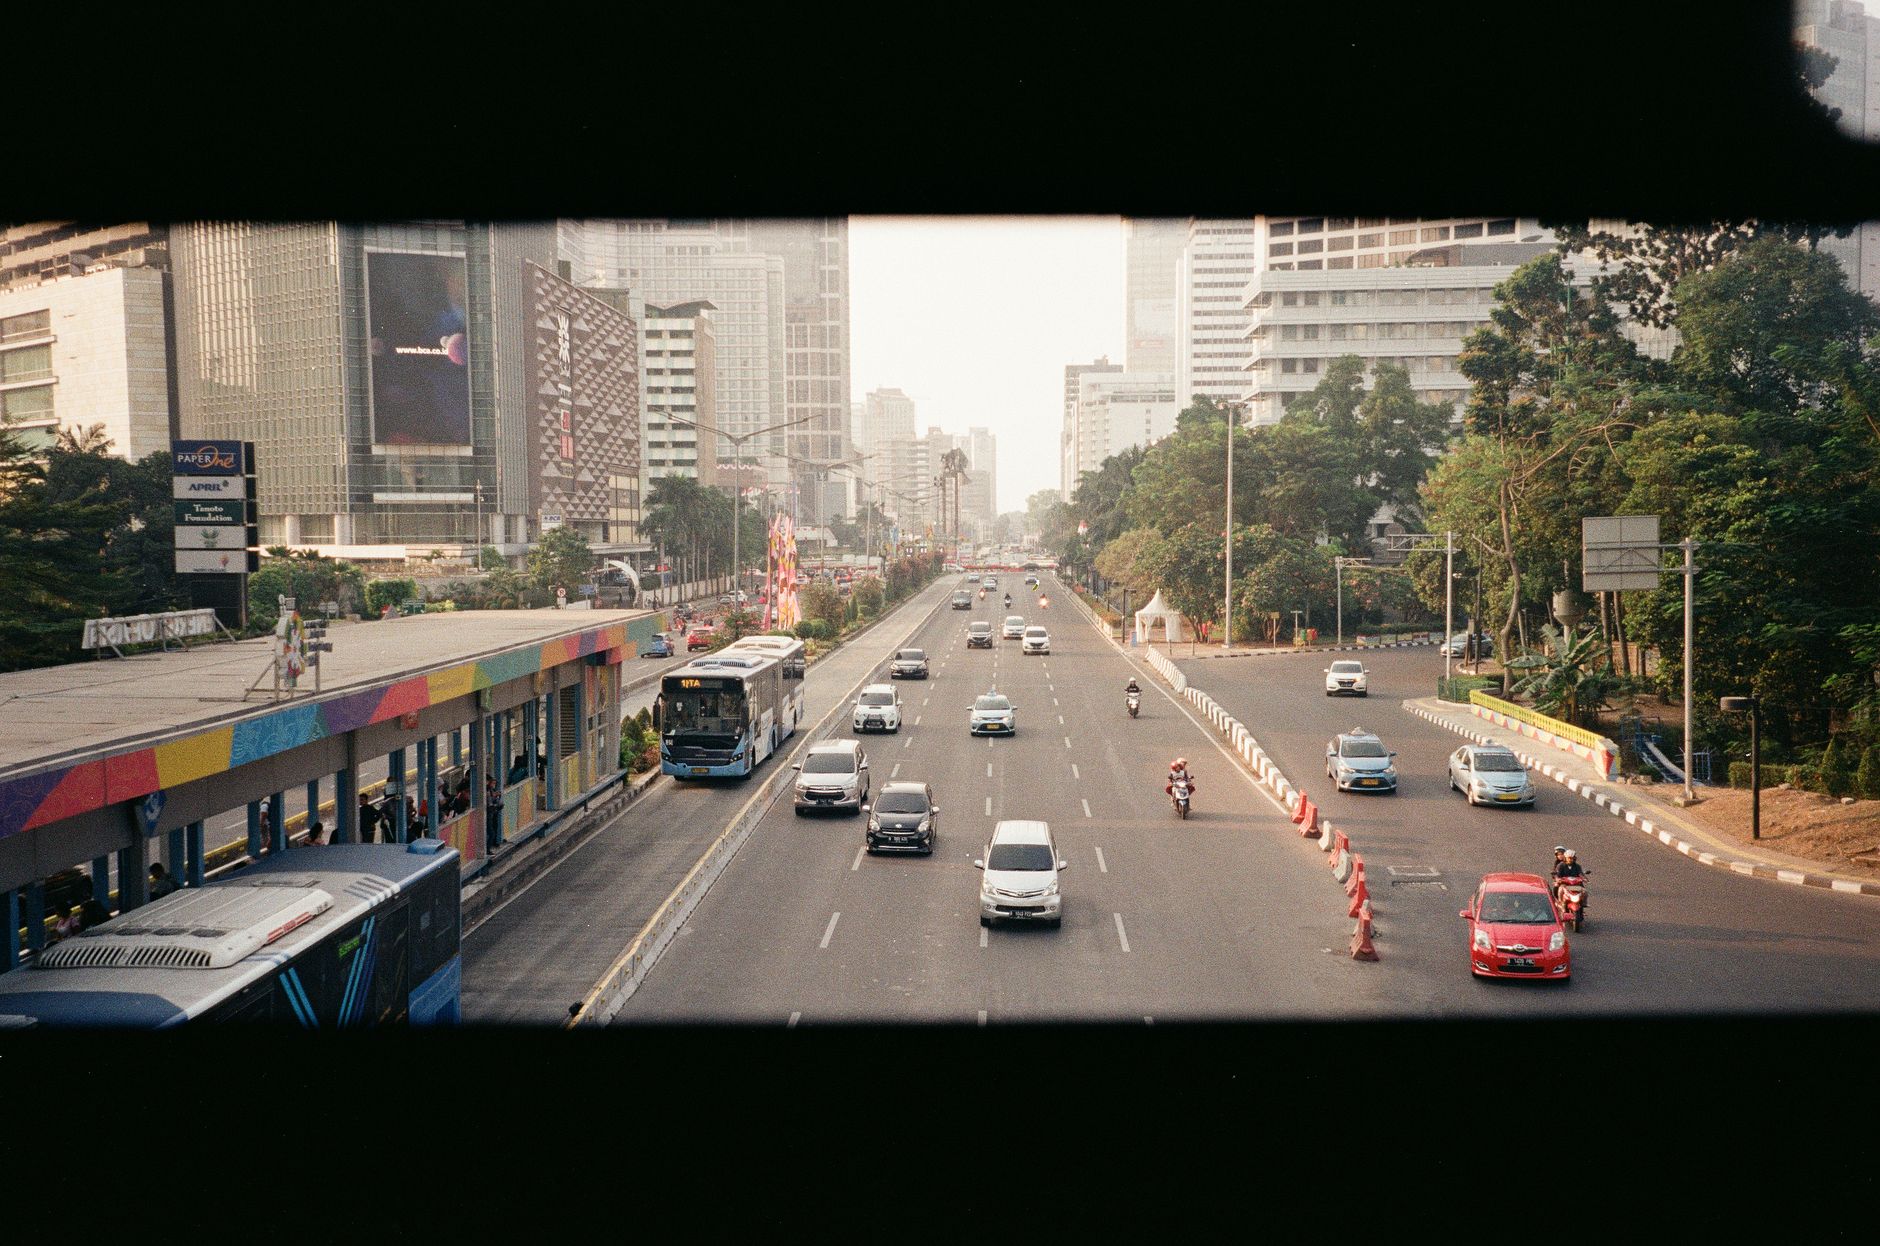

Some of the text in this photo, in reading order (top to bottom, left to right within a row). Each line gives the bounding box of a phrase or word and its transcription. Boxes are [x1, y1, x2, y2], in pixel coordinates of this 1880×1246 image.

[177, 454, 211, 464] PAPER
[189, 483, 222, 491] APRIL
[193, 503, 224, 512] Tanoto
[184, 512, 233, 522] Foundation
